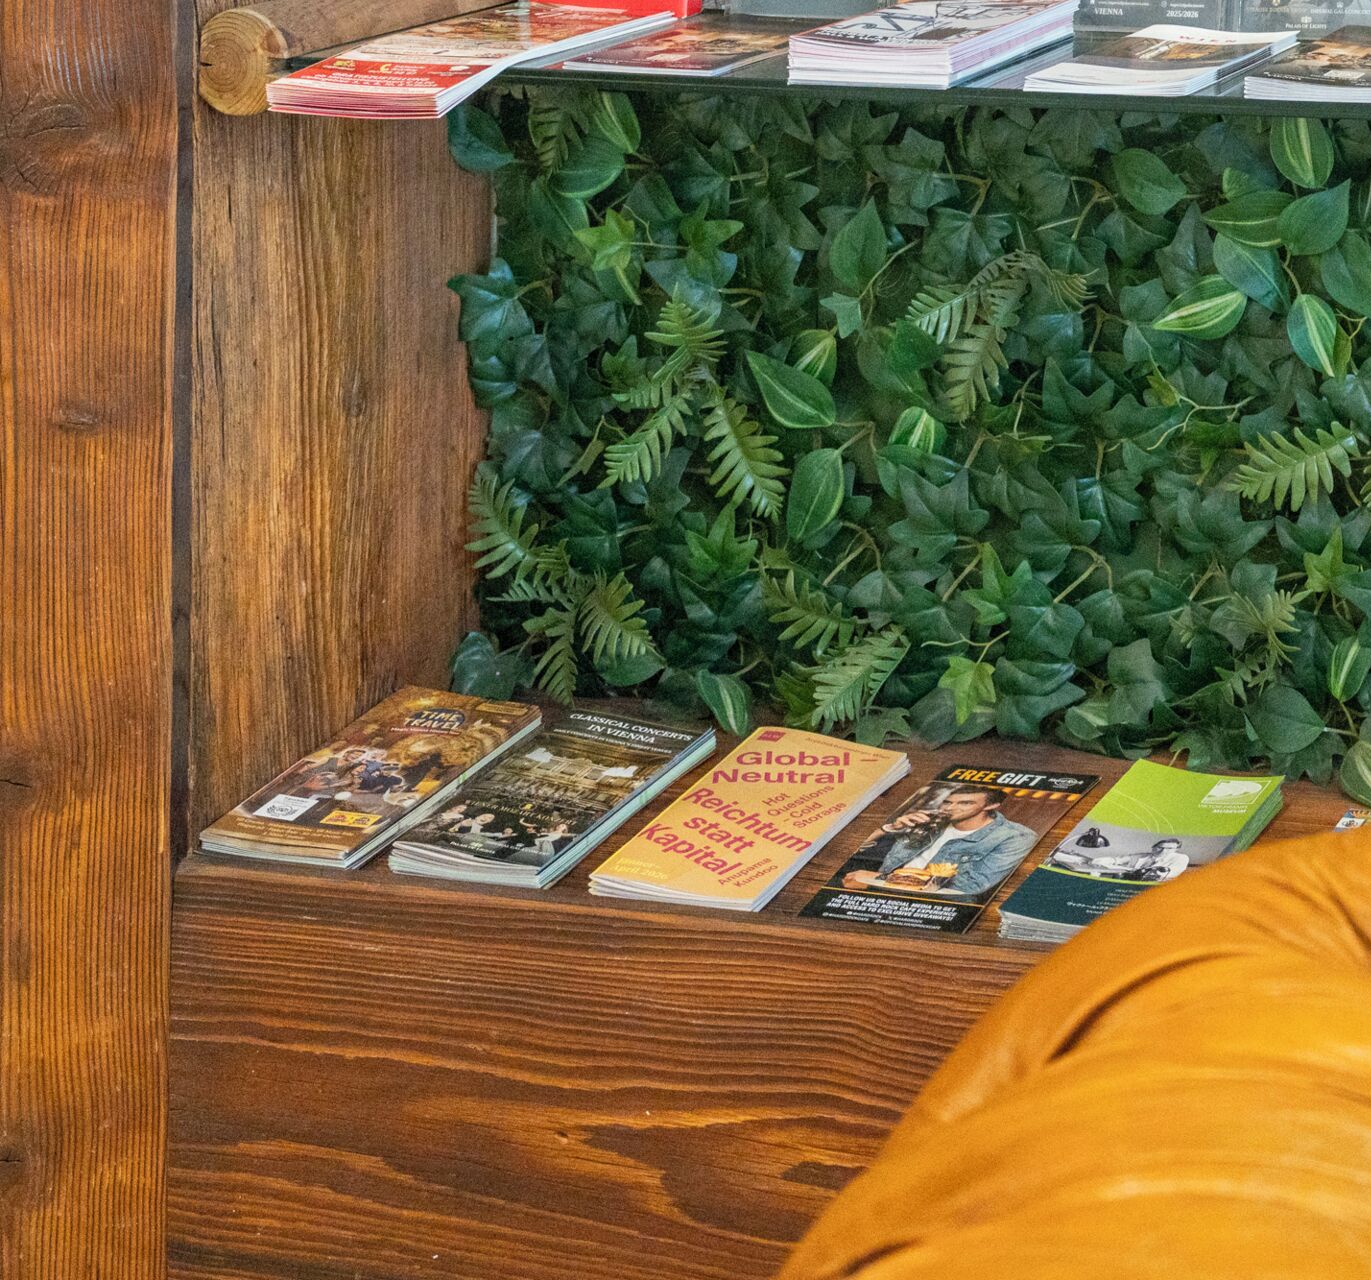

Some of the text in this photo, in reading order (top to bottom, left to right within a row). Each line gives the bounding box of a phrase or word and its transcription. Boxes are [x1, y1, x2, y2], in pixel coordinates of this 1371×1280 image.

[1094, 8, 1124, 16] VIENNA
[403, 718, 461, 730] TRAVEL
[569, 713, 631, 730] CLASSICAL
[631, 724, 694, 742] CONCERTS
[587, 724, 605, 733] IN
[605, 727, 656, 744] VIENNA
[735, 751, 850, 767] Global
[712, 768, 845, 784] Neutral
[947, 768, 1001, 783] FREE
[996, 772, 1047, 787] GIFT
[762, 792, 791, 806] Hot
[767, 785, 835, 817] Questions
[683, 787, 812, 852] Reichtum
[789, 801, 823, 819] Cold
[793, 802, 847, 828] Storage
[683, 814, 755, 854] statt
[640, 823, 743, 875] Kapital
[718, 858, 772, 885] Anupama
[734, 865, 778, 887] Kundoo
[838, 894, 866, 902] FOLLOW
[886, 899, 909, 907] SOCIAL
[910, 902, 932, 910] MEDIA
[877, 908, 913, 917] EXCLUSIVE
[916, 908, 958, 917] EXPERIENCE
